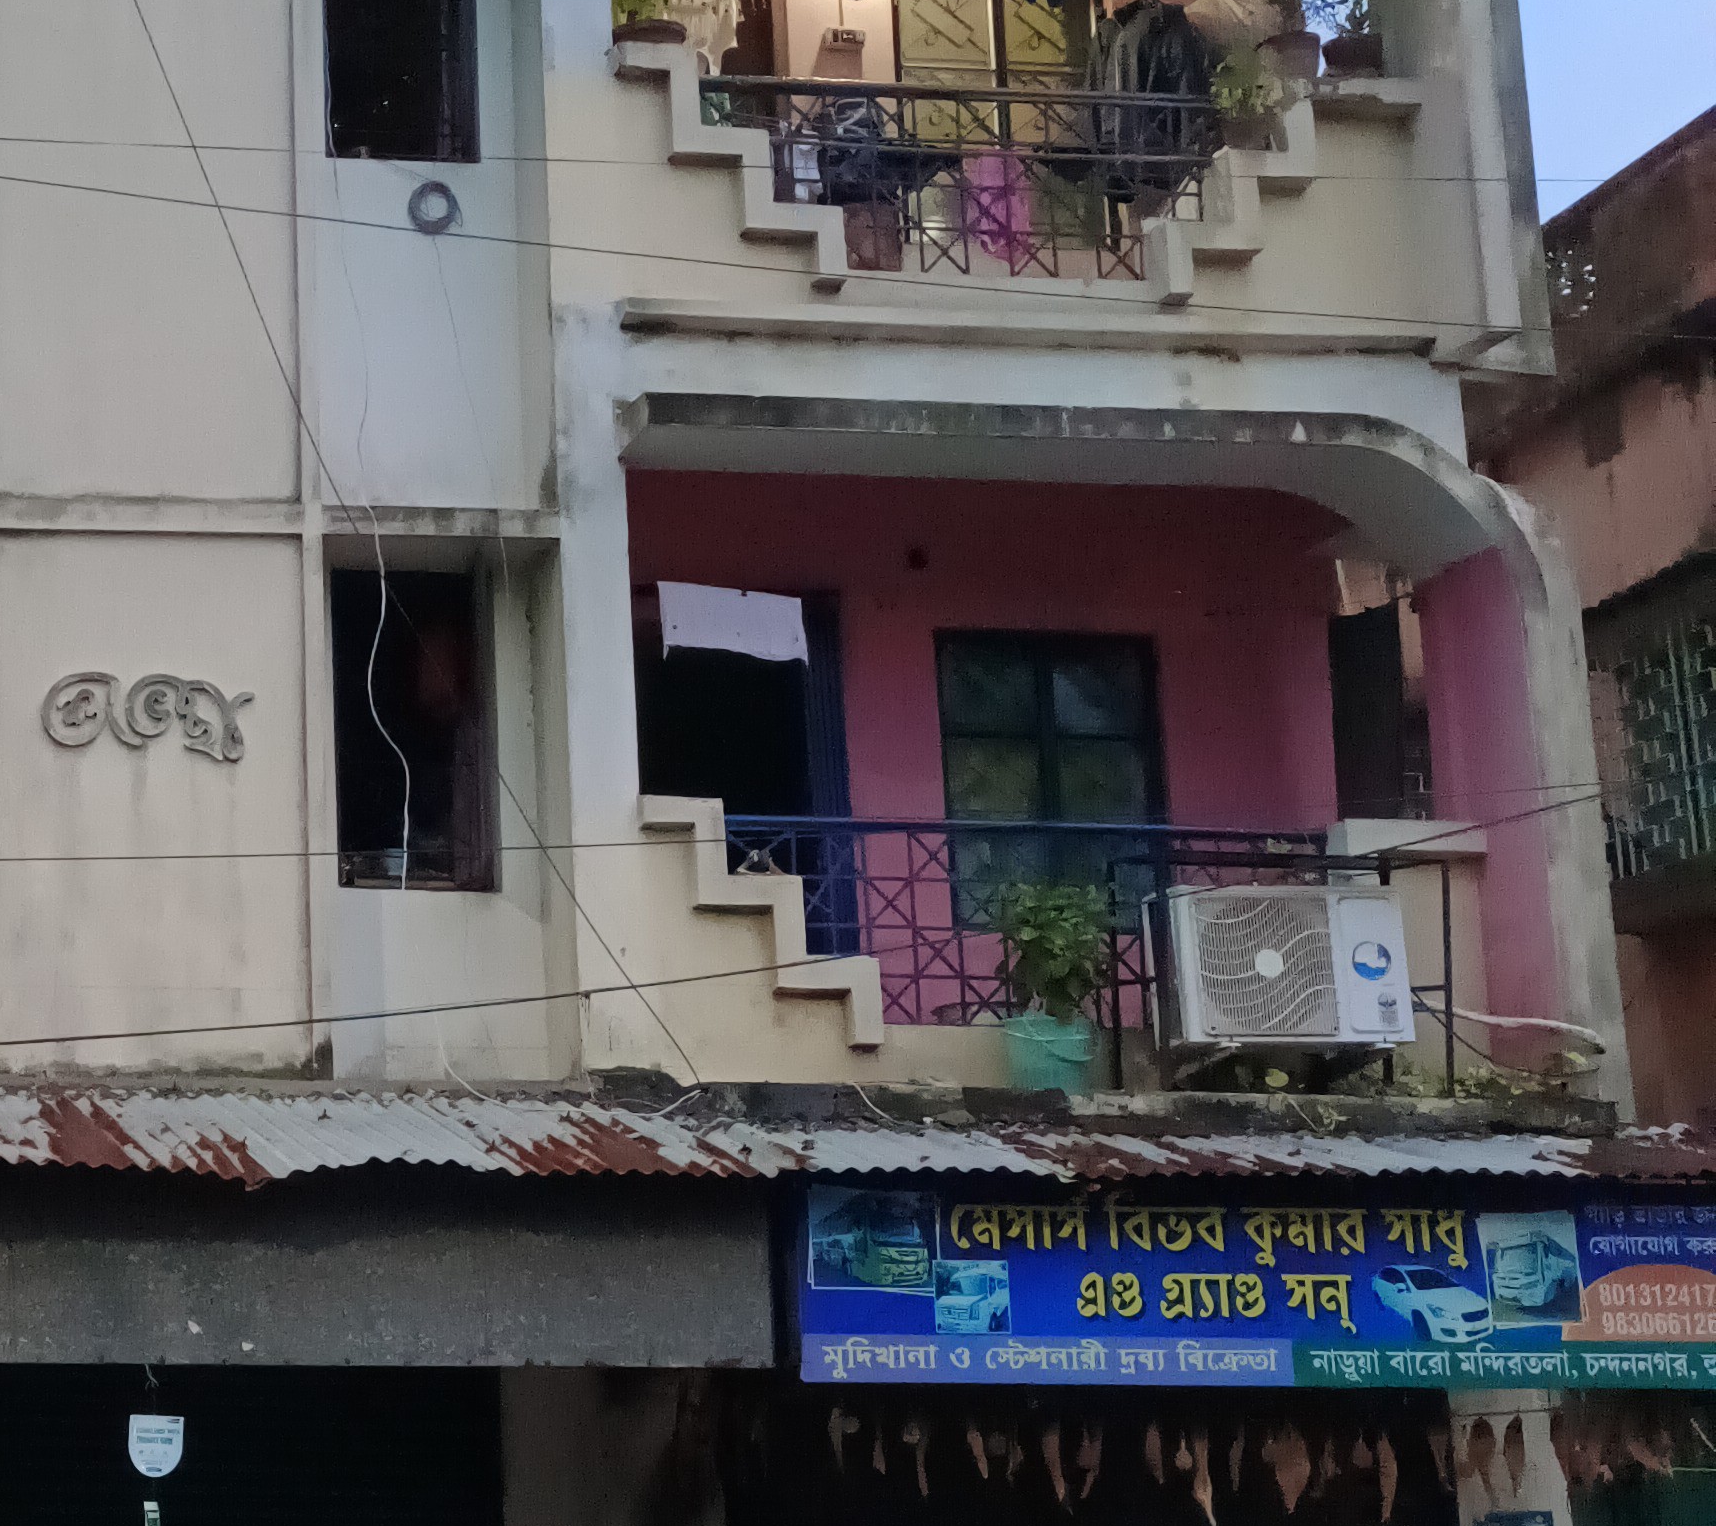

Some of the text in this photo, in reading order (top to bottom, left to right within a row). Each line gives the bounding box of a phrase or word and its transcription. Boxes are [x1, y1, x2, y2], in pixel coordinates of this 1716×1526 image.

[1104, 1196, 1226, 1252] বিভব
[1240, 1206, 1367, 1268] কুমার
[1381, 1208, 1469, 1271] সাধু
[1281, 1273, 1357, 1335] সন্
[822, 1336, 940, 1379] মুদিখানা
[949, 1346, 971, 1369] ও
[1116, 1348, 1166, 1375] দ্রব্য
[1176, 1340, 1279, 1373] বিক্রেতা
[1386, 1348, 1452, 1377] বারো
